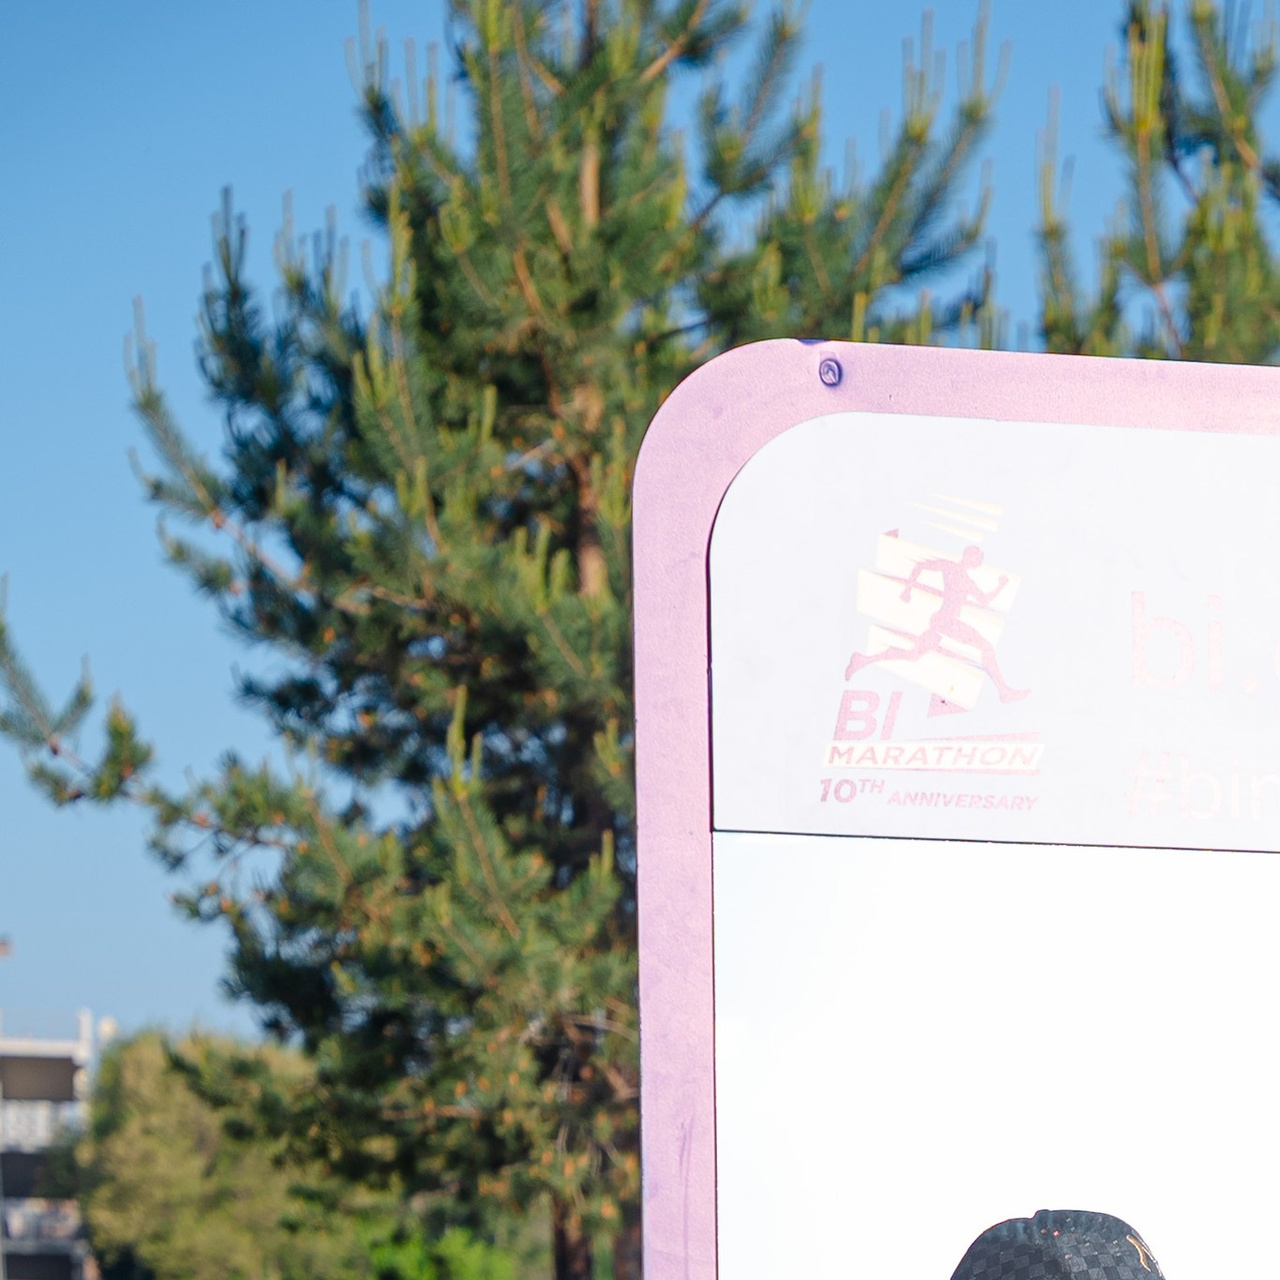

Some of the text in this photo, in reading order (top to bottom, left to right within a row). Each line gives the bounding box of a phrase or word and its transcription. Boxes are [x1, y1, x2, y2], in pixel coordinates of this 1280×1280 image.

[832, 689, 903, 741] BI
[827, 745, 1039, 767] MARATHON
[819, 777, 1039, 811] 10TH ANNIVERSARY
